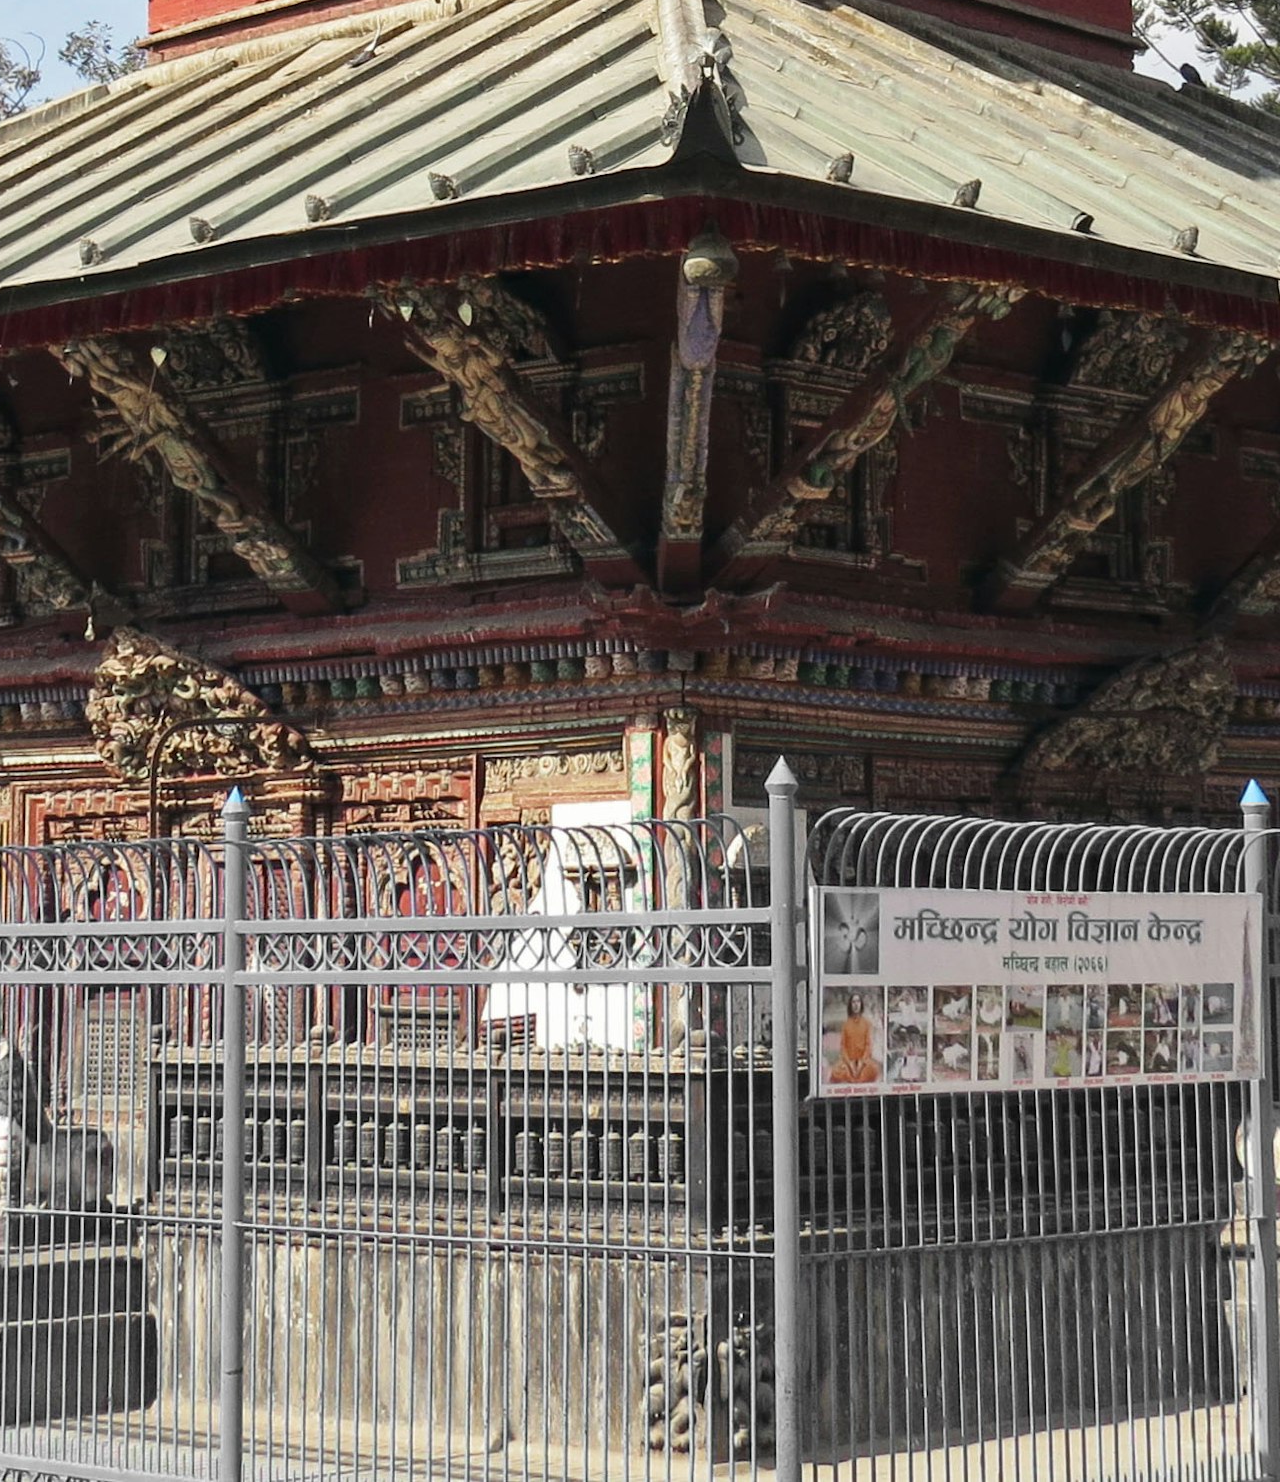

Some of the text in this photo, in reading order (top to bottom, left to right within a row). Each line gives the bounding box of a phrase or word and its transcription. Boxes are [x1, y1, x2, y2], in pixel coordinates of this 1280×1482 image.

[1008, 910, 1060, 942] योग
[1067, 910, 1140, 943] विज्ञान
[1147, 911, 1203, 945] केन्द्र
[1044, 955, 1069, 974] बहाल
